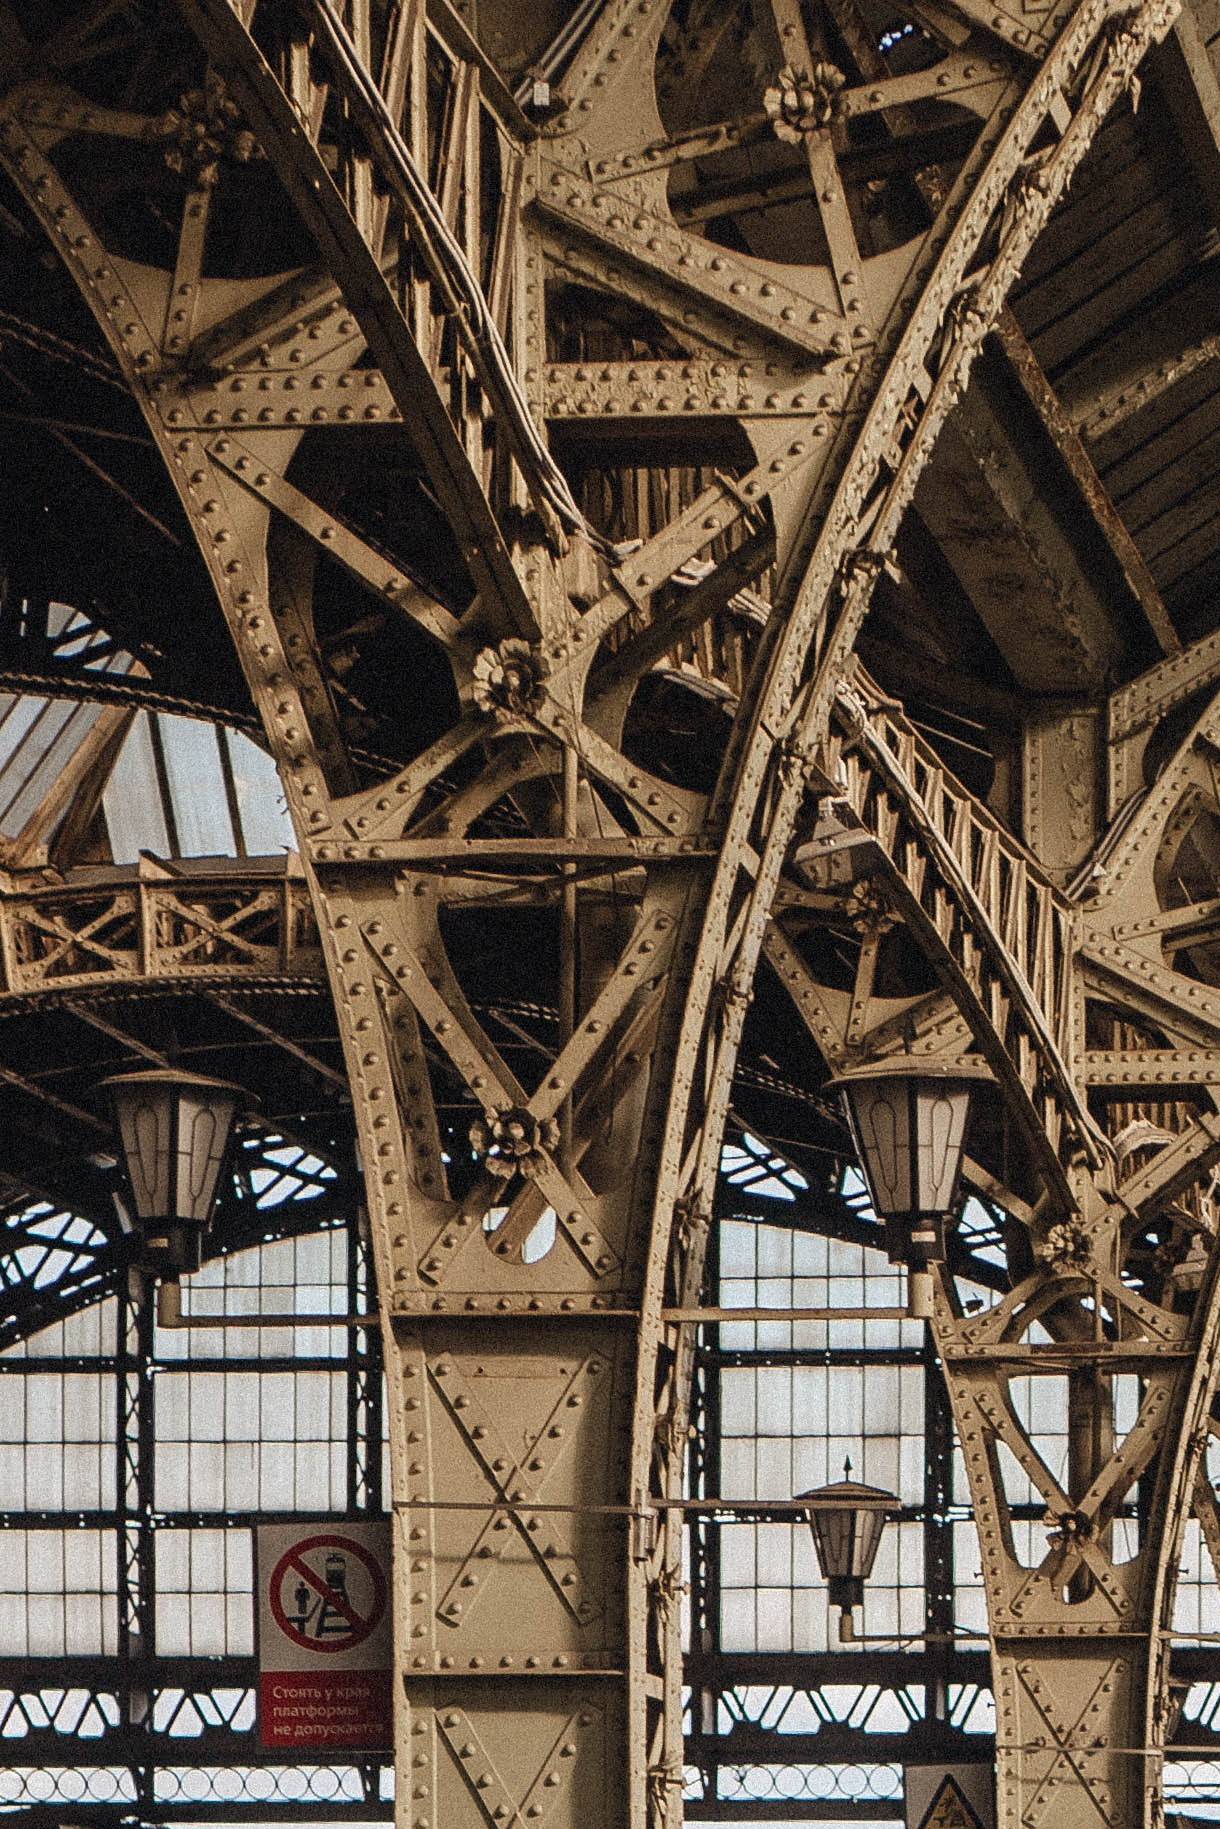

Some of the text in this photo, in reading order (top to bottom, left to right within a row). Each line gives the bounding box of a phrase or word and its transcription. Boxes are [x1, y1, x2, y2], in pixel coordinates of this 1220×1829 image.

[273, 1685, 370, 1701] Стоять у края
[273, 1705, 359, 1719] платформы
[273, 1724, 384, 1738] не допускается
